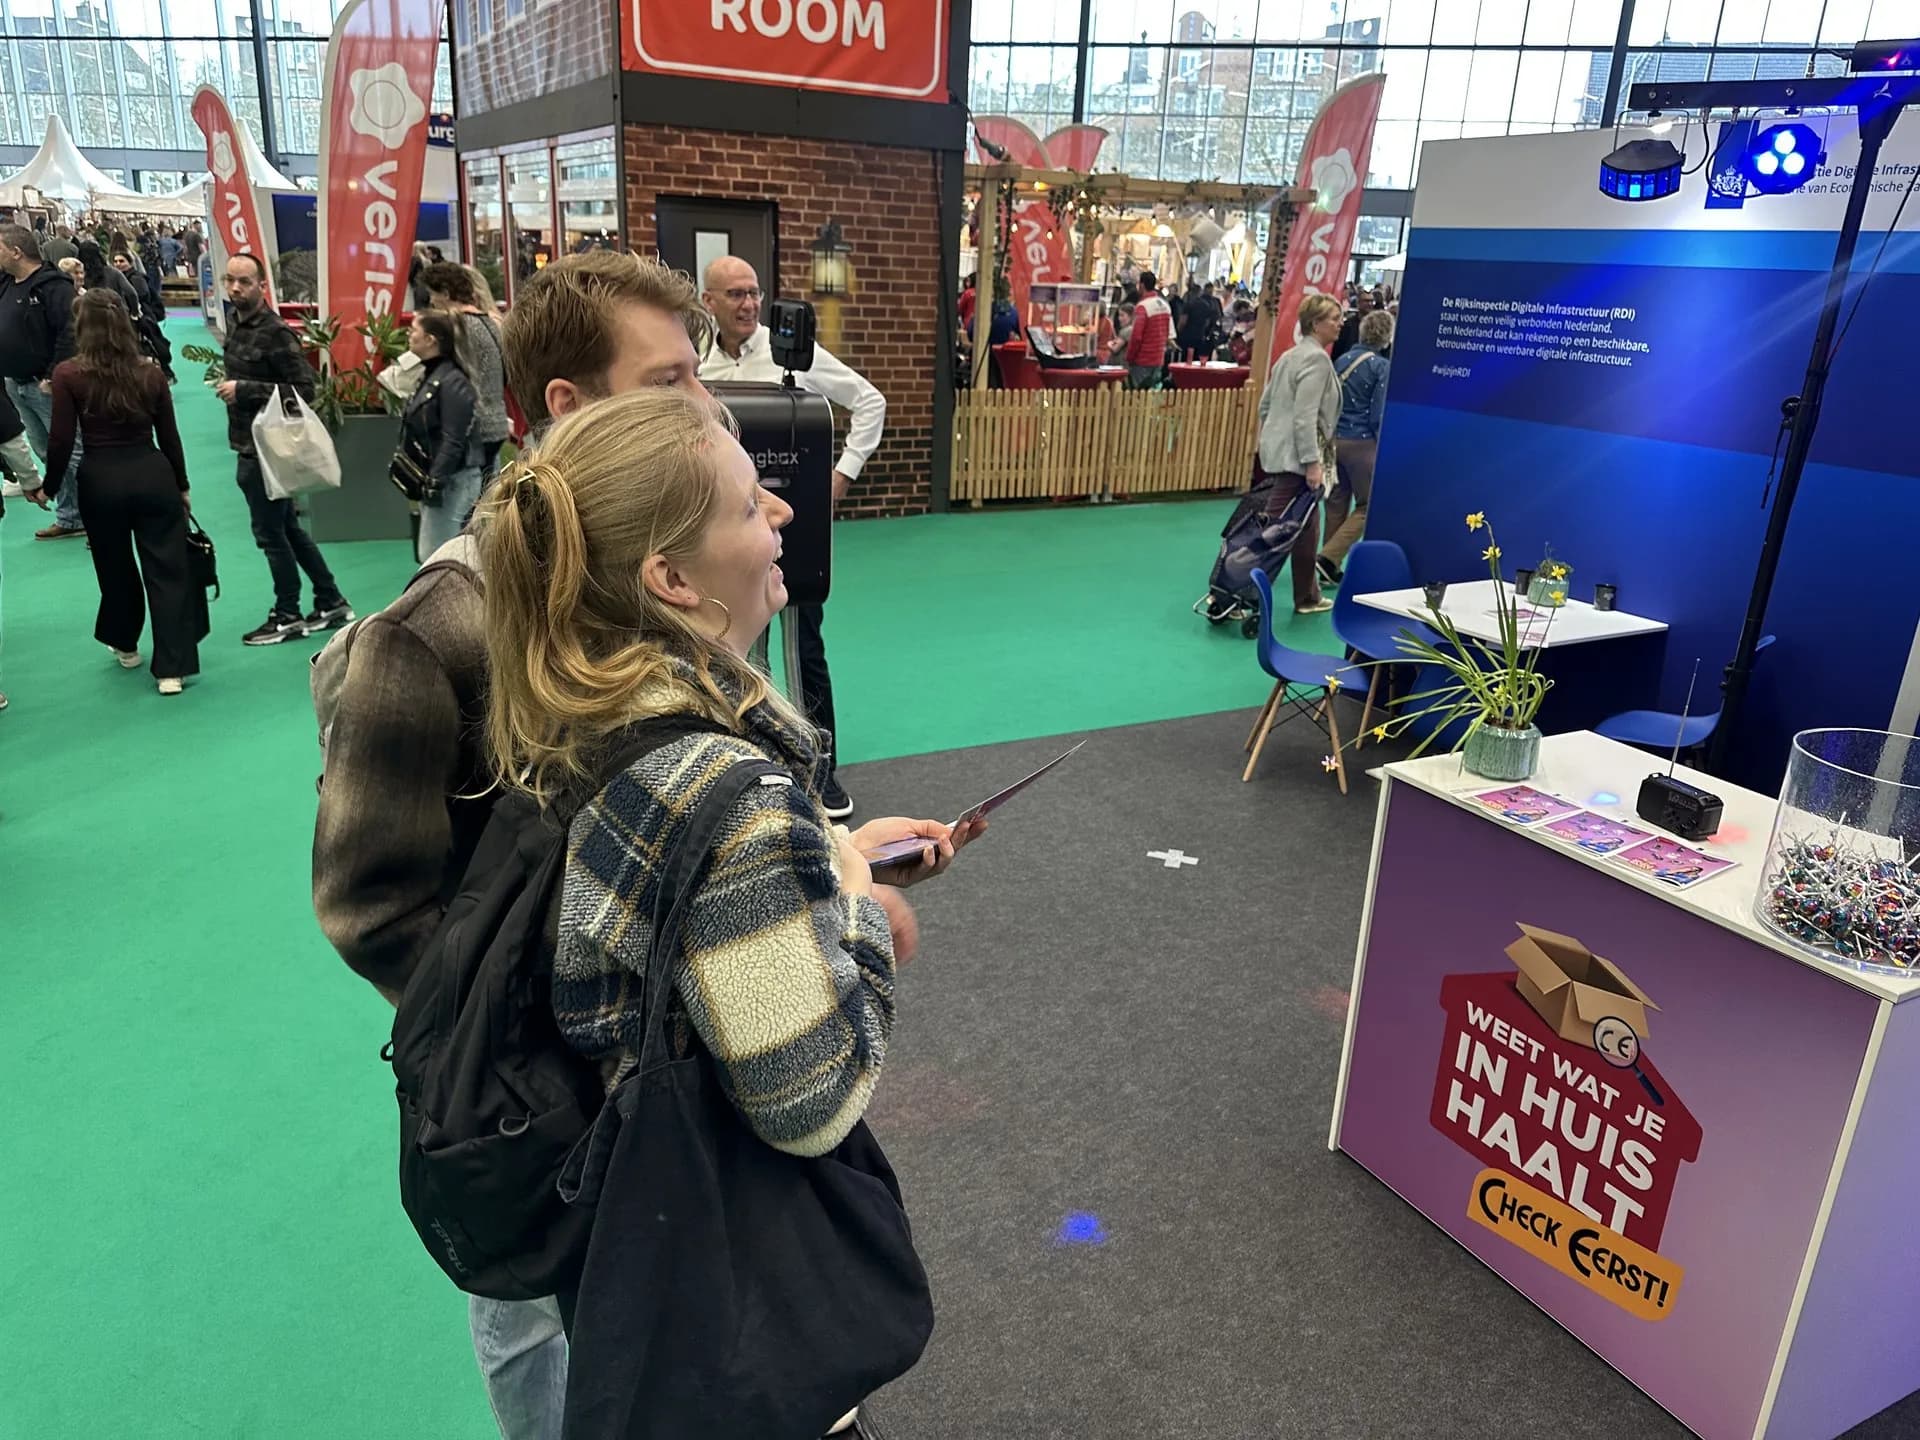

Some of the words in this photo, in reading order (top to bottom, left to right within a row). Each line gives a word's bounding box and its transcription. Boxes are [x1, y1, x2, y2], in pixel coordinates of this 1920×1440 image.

[711, 0, 886, 51] ROOM
[428, 125, 455, 143] urg
[1808, 184, 1827, 194] van
[1440, 312, 1459, 322] staat
[1460, 314, 1478, 323] voor
[1479, 316, 1494, 325] een
[1495, 314, 1517, 329] veilig
[1517, 317, 1562, 330] verbonden
[1564, 320, 1613, 334] Nederland.
[1442, 297, 1453, 307] De
[1455, 298, 1510, 312] Rijksinspectie
[1511, 301, 1545, 315] Digitale
[1546, 303, 1609, 319] Infrastructuur
[1610, 307, 1636, 321] (RDI)
[1435, 337, 1485, 352] betrouwbare
[1485, 344, 1496, 353] en
[1496, 344, 1535, 357] weerbare
[1535, 346, 1568, 361] digitale
[1568, 349, 1633, 367] infrastructuur.
[1438, 324, 1452, 335] Een
[1453, 325, 1493, 339] Nederland
[1494, 328, 1508, 340] dat
[1508, 330, 1524, 341] kan
[1524, 331, 1559, 345] rekenen
[1560, 336, 1573, 347] op
[1573, 337, 1590, 347] een
[1592, 336, 1650, 354] beschikbare,
[1466, 999, 1546, 1064] WEET
[1552, 1052, 1620, 1110] WAT
[1624, 1104, 1666, 1142] JE
[1455, 1031, 1509, 1097] IN
[1519, 1072, 1657, 1191] HUIS
[1445, 1078, 1645, 1237] HAALT
